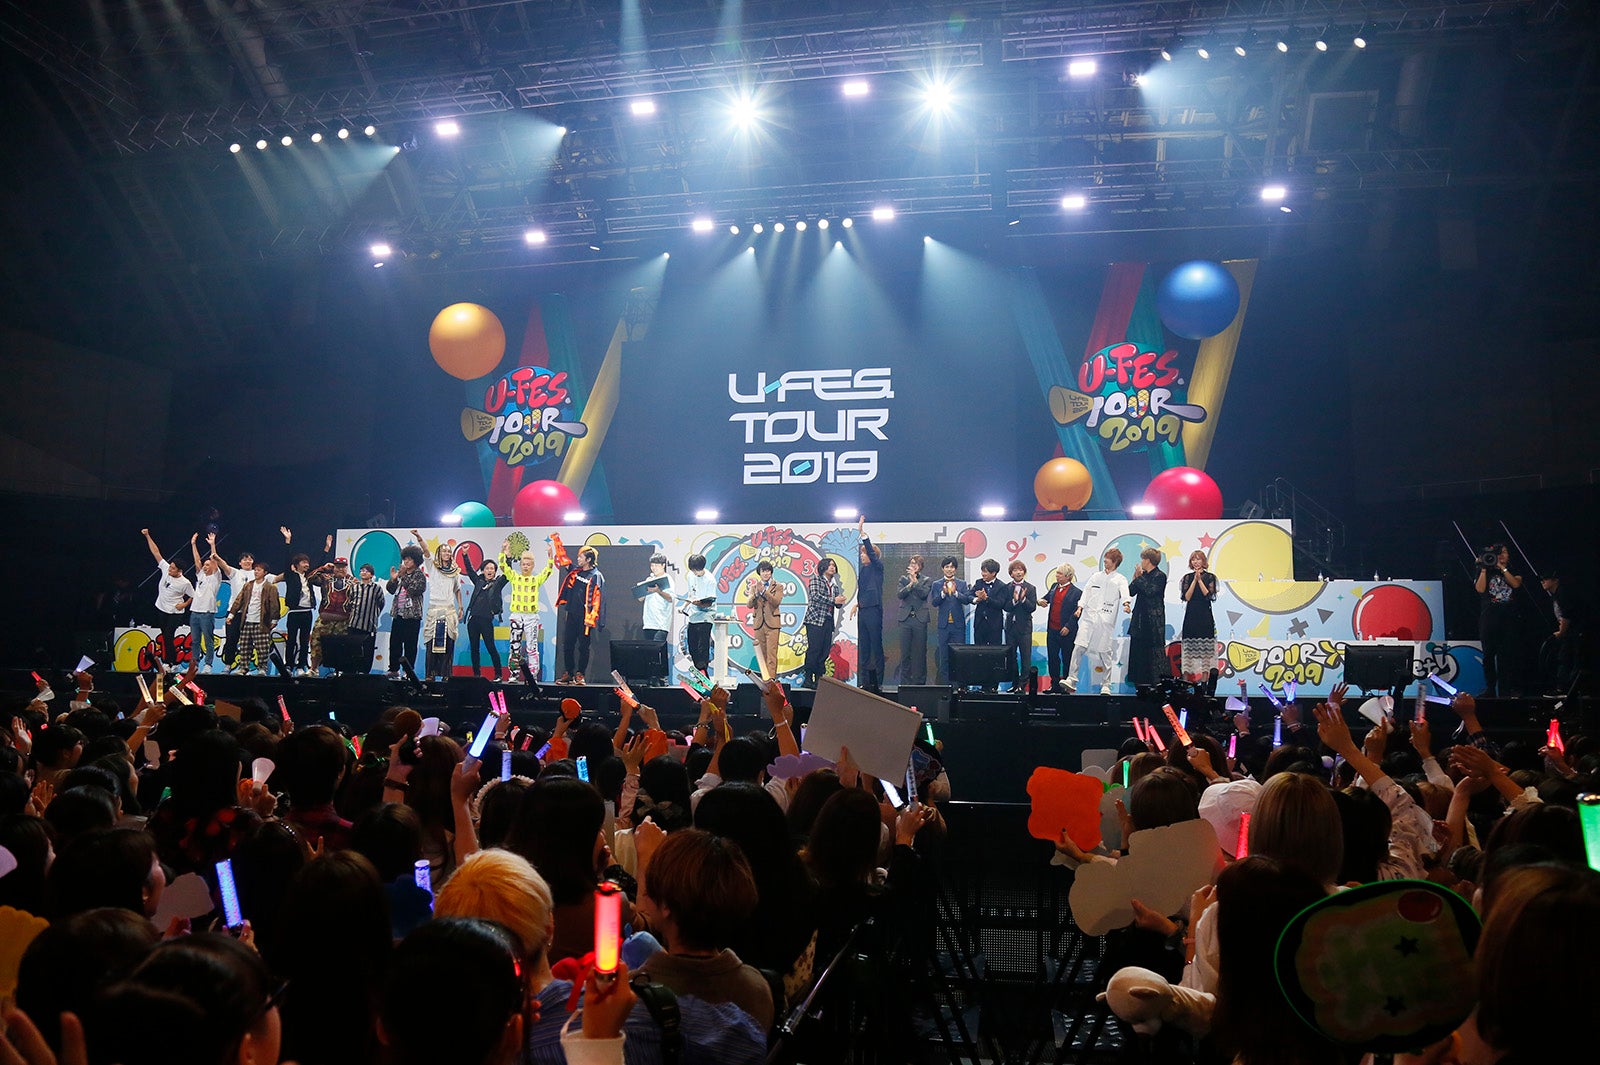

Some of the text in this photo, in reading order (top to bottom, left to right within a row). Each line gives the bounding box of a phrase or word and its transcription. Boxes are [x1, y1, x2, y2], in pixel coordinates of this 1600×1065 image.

[728, 408, 889, 444] TOUR
[1099, 414, 1180, 451] 2019
[499, 431, 565, 465] 2019
[743, 450, 878, 485] 2019
[801, 558, 818, 577] 3
[1264, 662, 1322, 690] 2019
